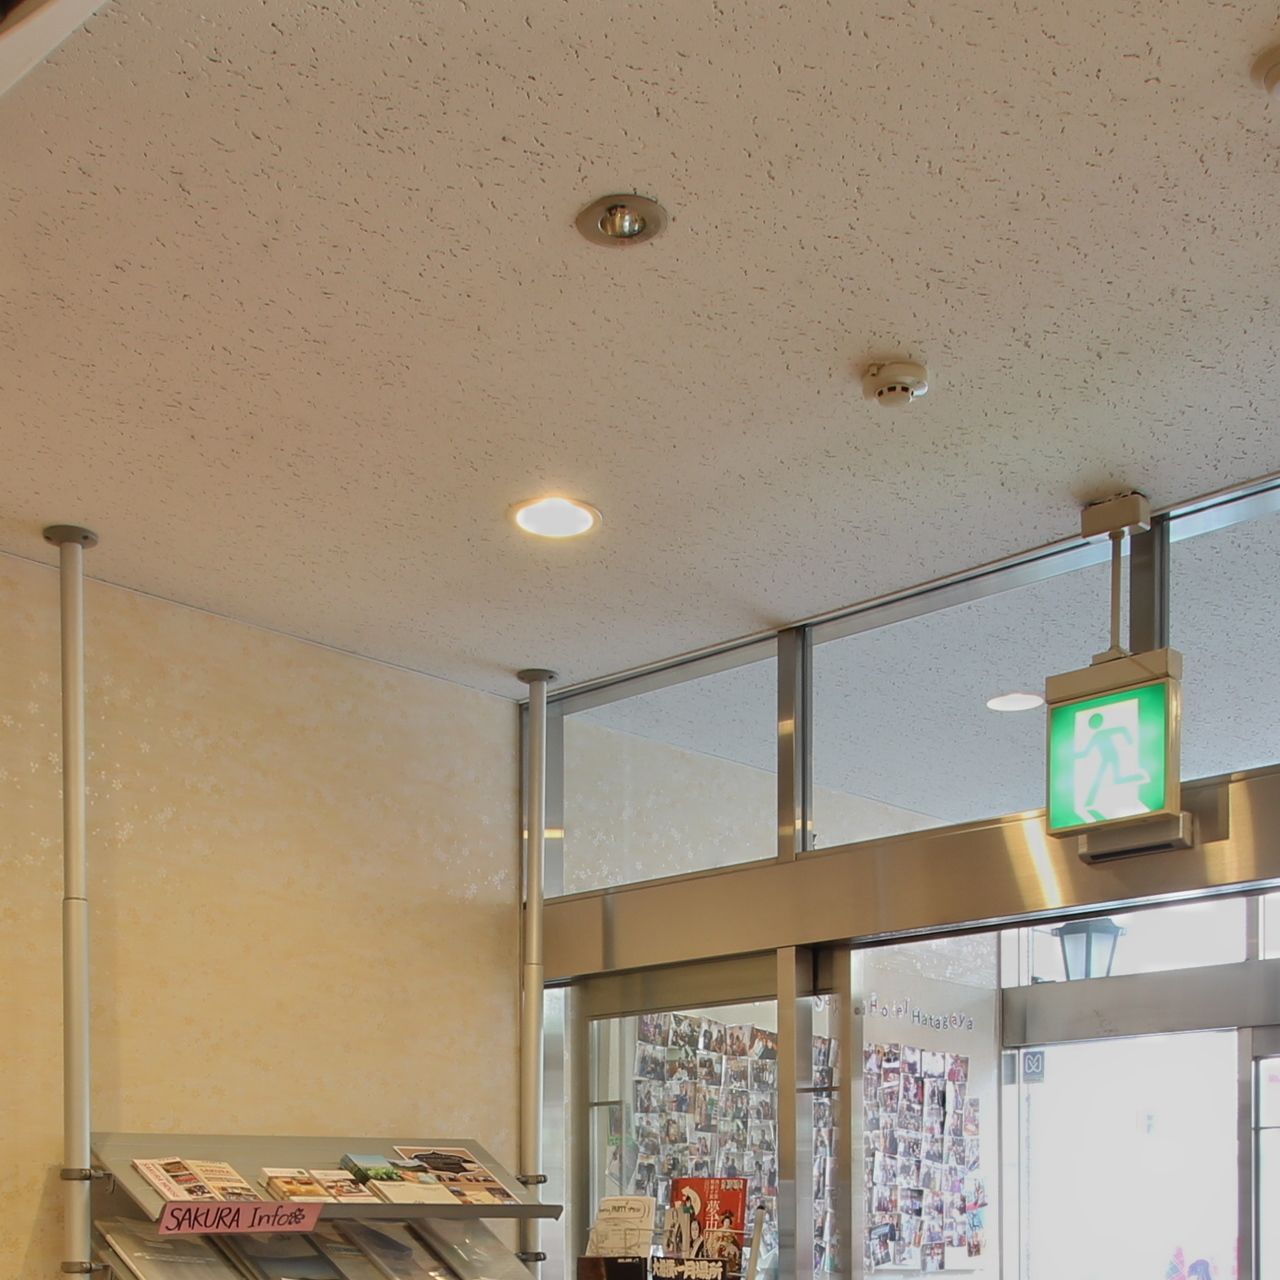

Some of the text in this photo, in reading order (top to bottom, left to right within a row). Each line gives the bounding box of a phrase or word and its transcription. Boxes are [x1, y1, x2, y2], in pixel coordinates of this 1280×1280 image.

[912, 1006, 973, 1030] Hatagaya
[165, 1205, 292, 1231] SAKURA Info
